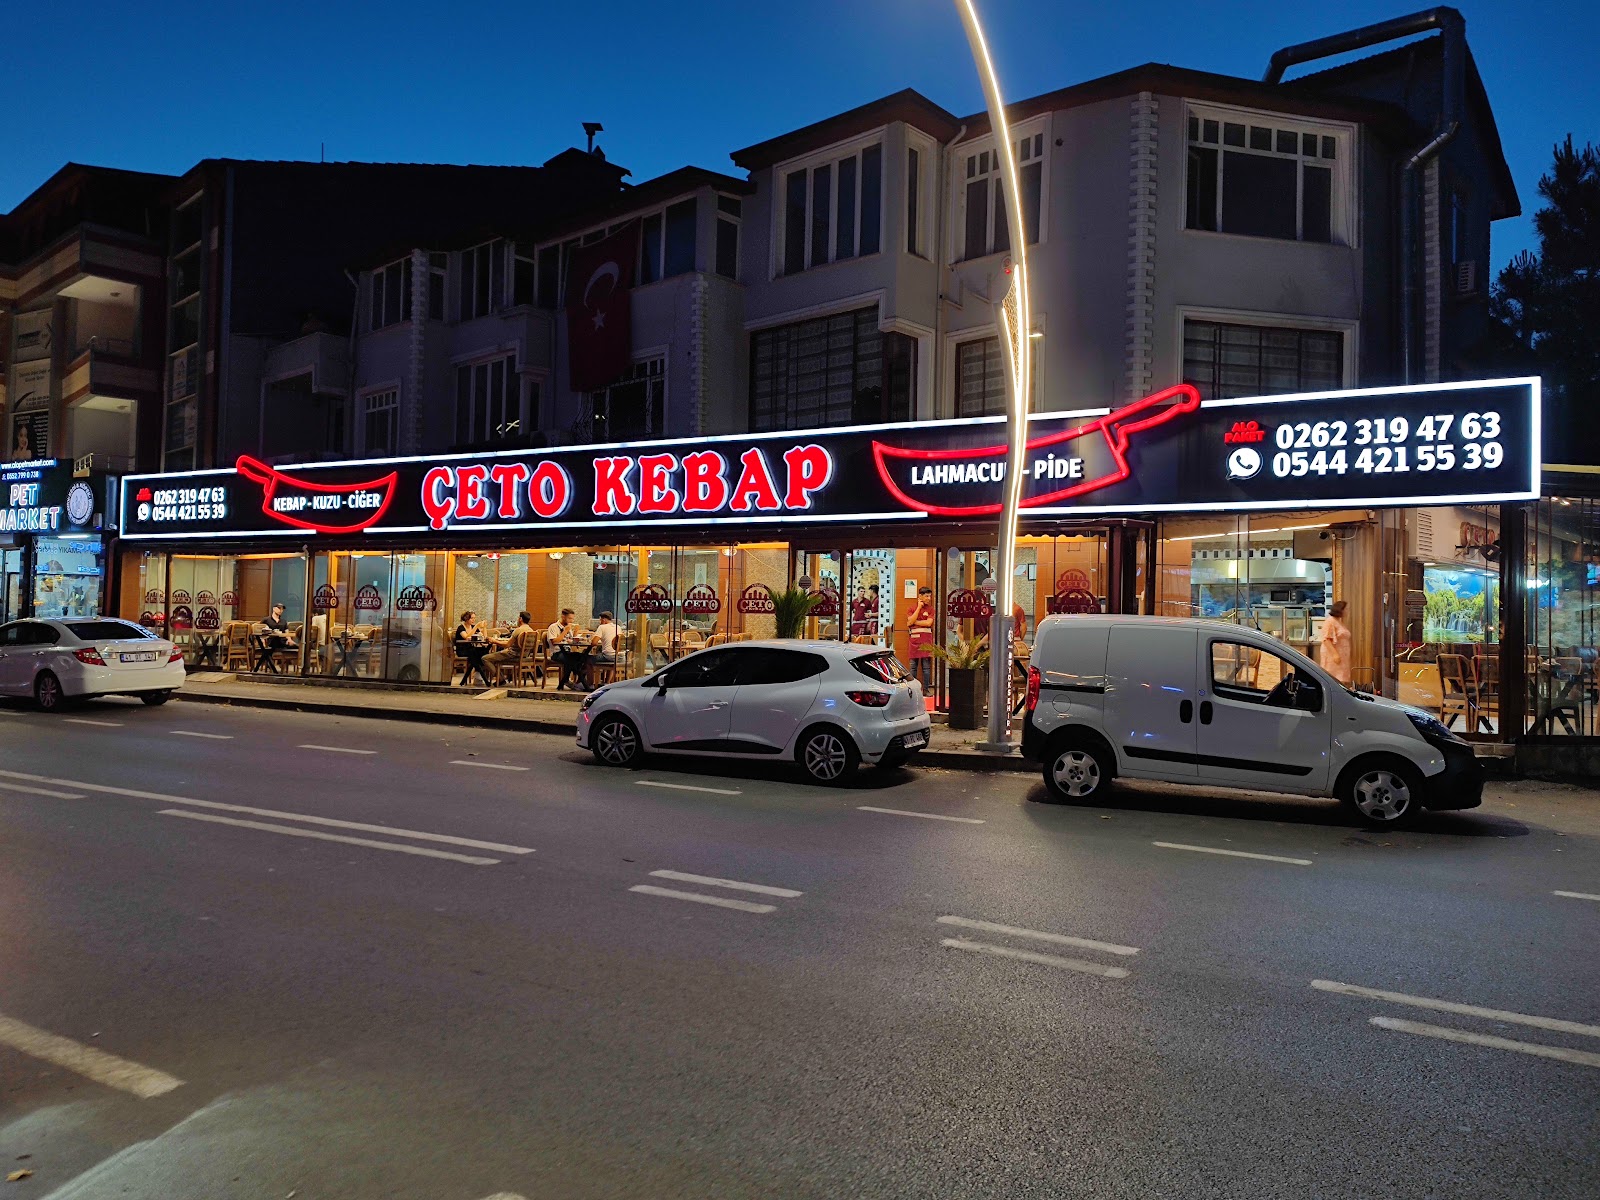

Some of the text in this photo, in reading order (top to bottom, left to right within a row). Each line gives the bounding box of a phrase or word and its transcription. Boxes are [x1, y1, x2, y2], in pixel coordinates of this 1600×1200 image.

[1224, 430, 1265, 443] PAKET
[1231, 420, 1260, 433] ALO
[1275, 411, 1501, 450] 0262 319 47 63
[911, 461, 1006, 485] LAHMACU
[1034, 453, 1084, 480] PİDE
[1272, 441, 1504, 478] 0544 421 55 39
[10, 484, 38, 507] PET
[153, 490, 178, 506] 0262
[178, 488, 197, 504] 319
[198, 487, 211, 502] 47
[211, 487, 225, 502] 63
[420, 444, 834, 530] ÇETO KEBAP
[152, 503, 225, 521] 0544 421 55 39
[273, 496, 307, 512] KEBAP
[312, 495, 341, 509] KUZU
[347, 490, 382, 508] CİĞER
